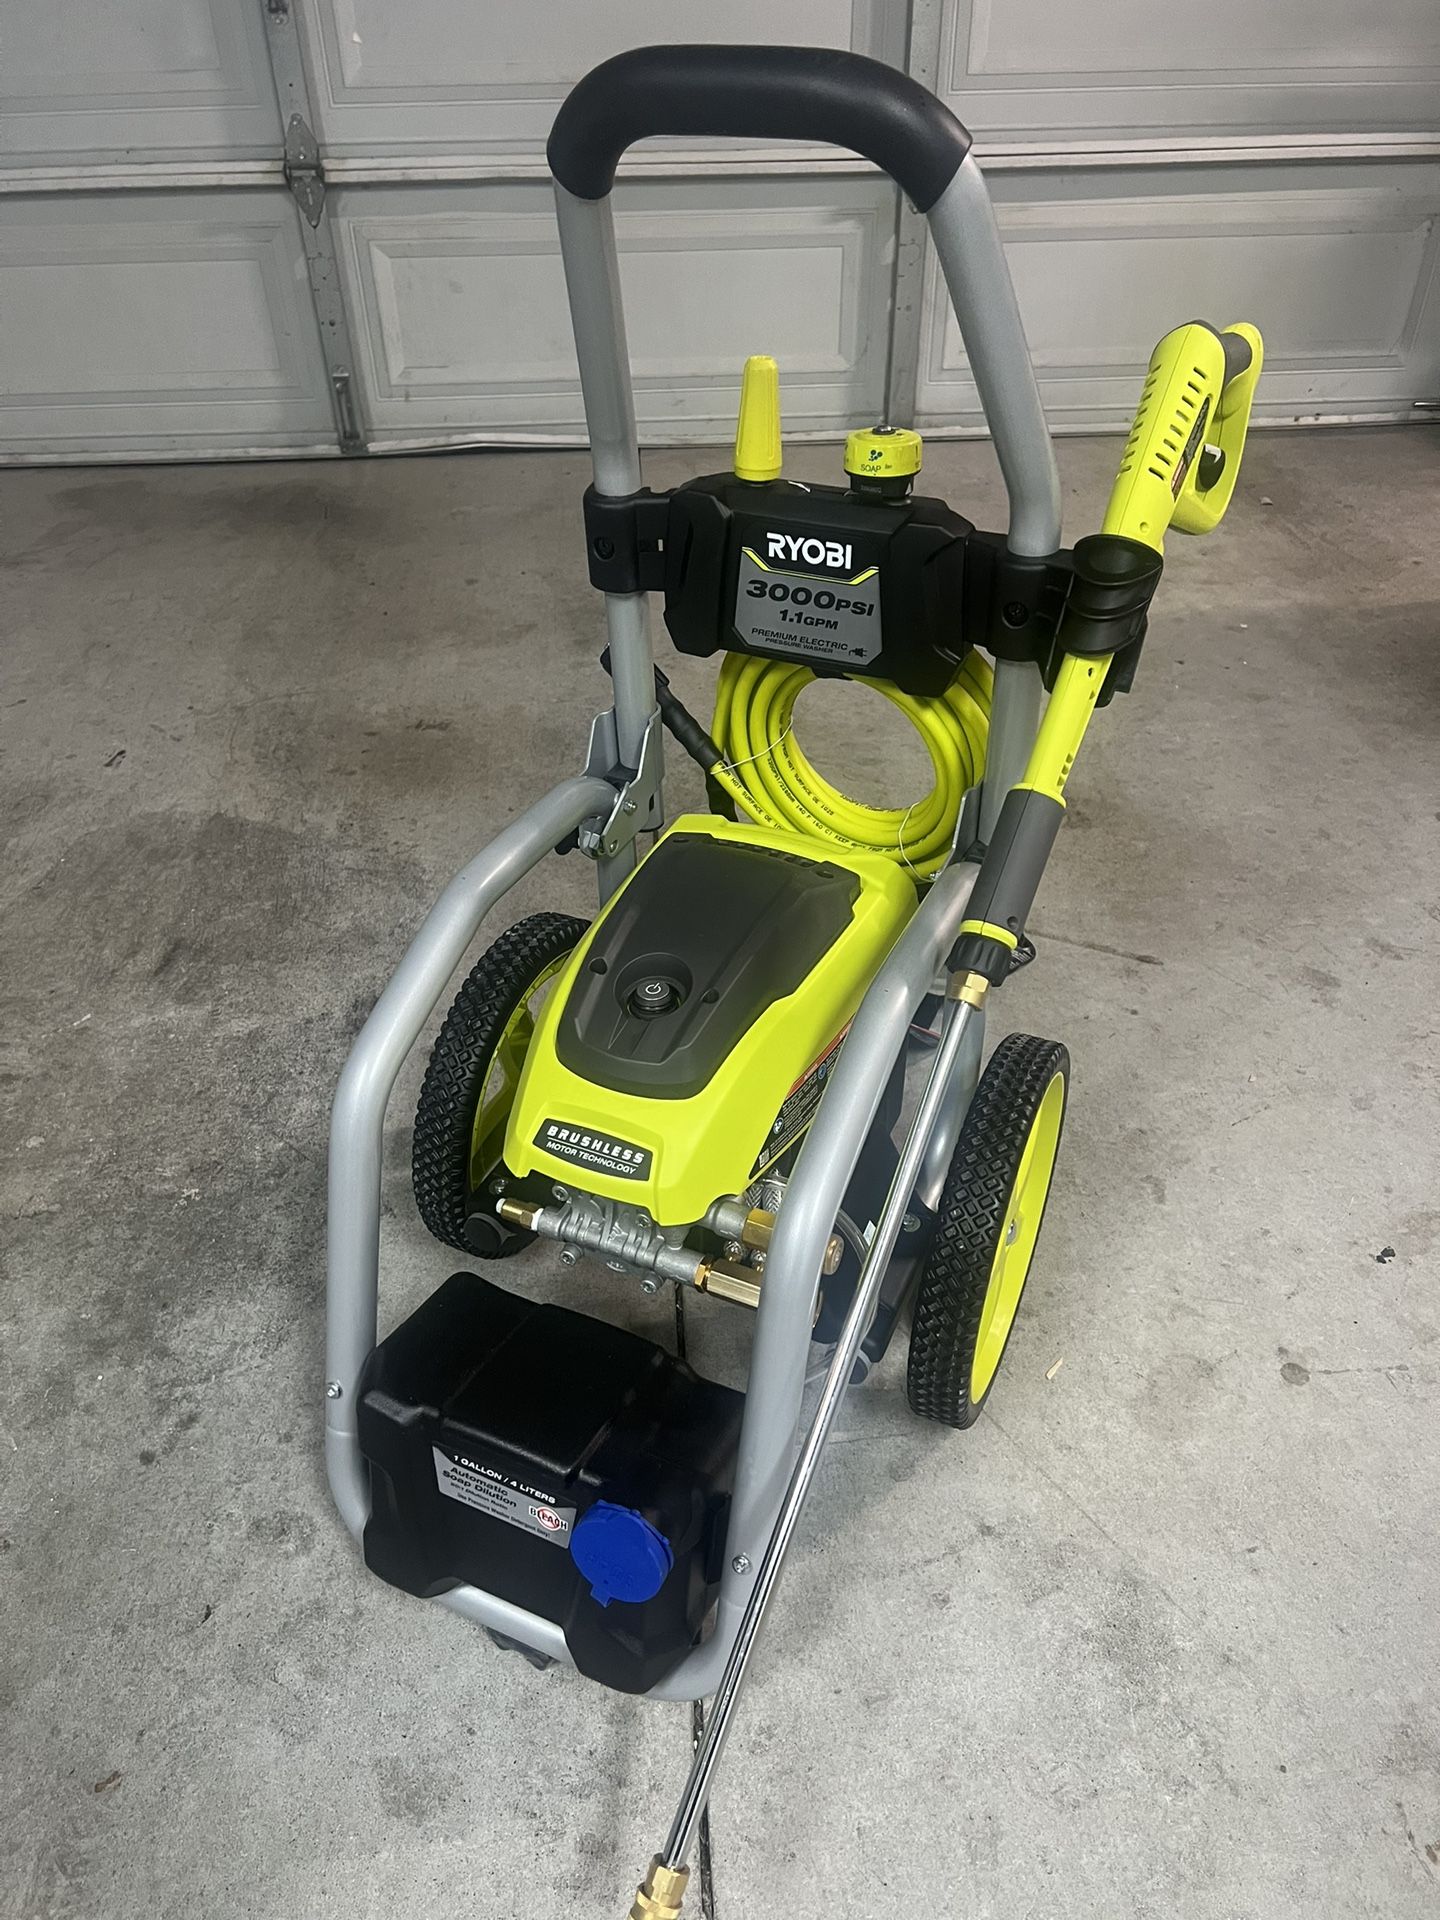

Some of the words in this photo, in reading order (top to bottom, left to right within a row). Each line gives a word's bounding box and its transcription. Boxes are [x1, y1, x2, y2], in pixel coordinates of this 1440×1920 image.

[860, 463, 882, 473] SOAP
[766, 532, 853, 570] RYOBI
[746, 579, 875, 617] 3000PSI
[779, 609, 839, 630] 1.1GPM
[751, 627, 798, 642] PREMIUM
[801, 636, 848, 651] ELECTRIC
[765, 637, 802, 649] PRESSURE
[803, 643, 833, 654] WASHER
[731, 777, 742, 790] HOT
[742, 790, 764, 815] SURFACE
[546, 1125, 645, 1164] BRUSHLESS
[546, 1141, 578, 1157] MOTOR
[578, 1150, 637, 1175] TECHNOLOGY
[442, 1470, 472, 1487] Soap
[474, 1484, 517, 1508] Dilution
[450, 1467, 509, 1496] Automatic
[460, 1458, 503, 1481] GALLON
[510, 1480, 517, 1488] 4
[519, 1483, 556, 1505] LITERS
